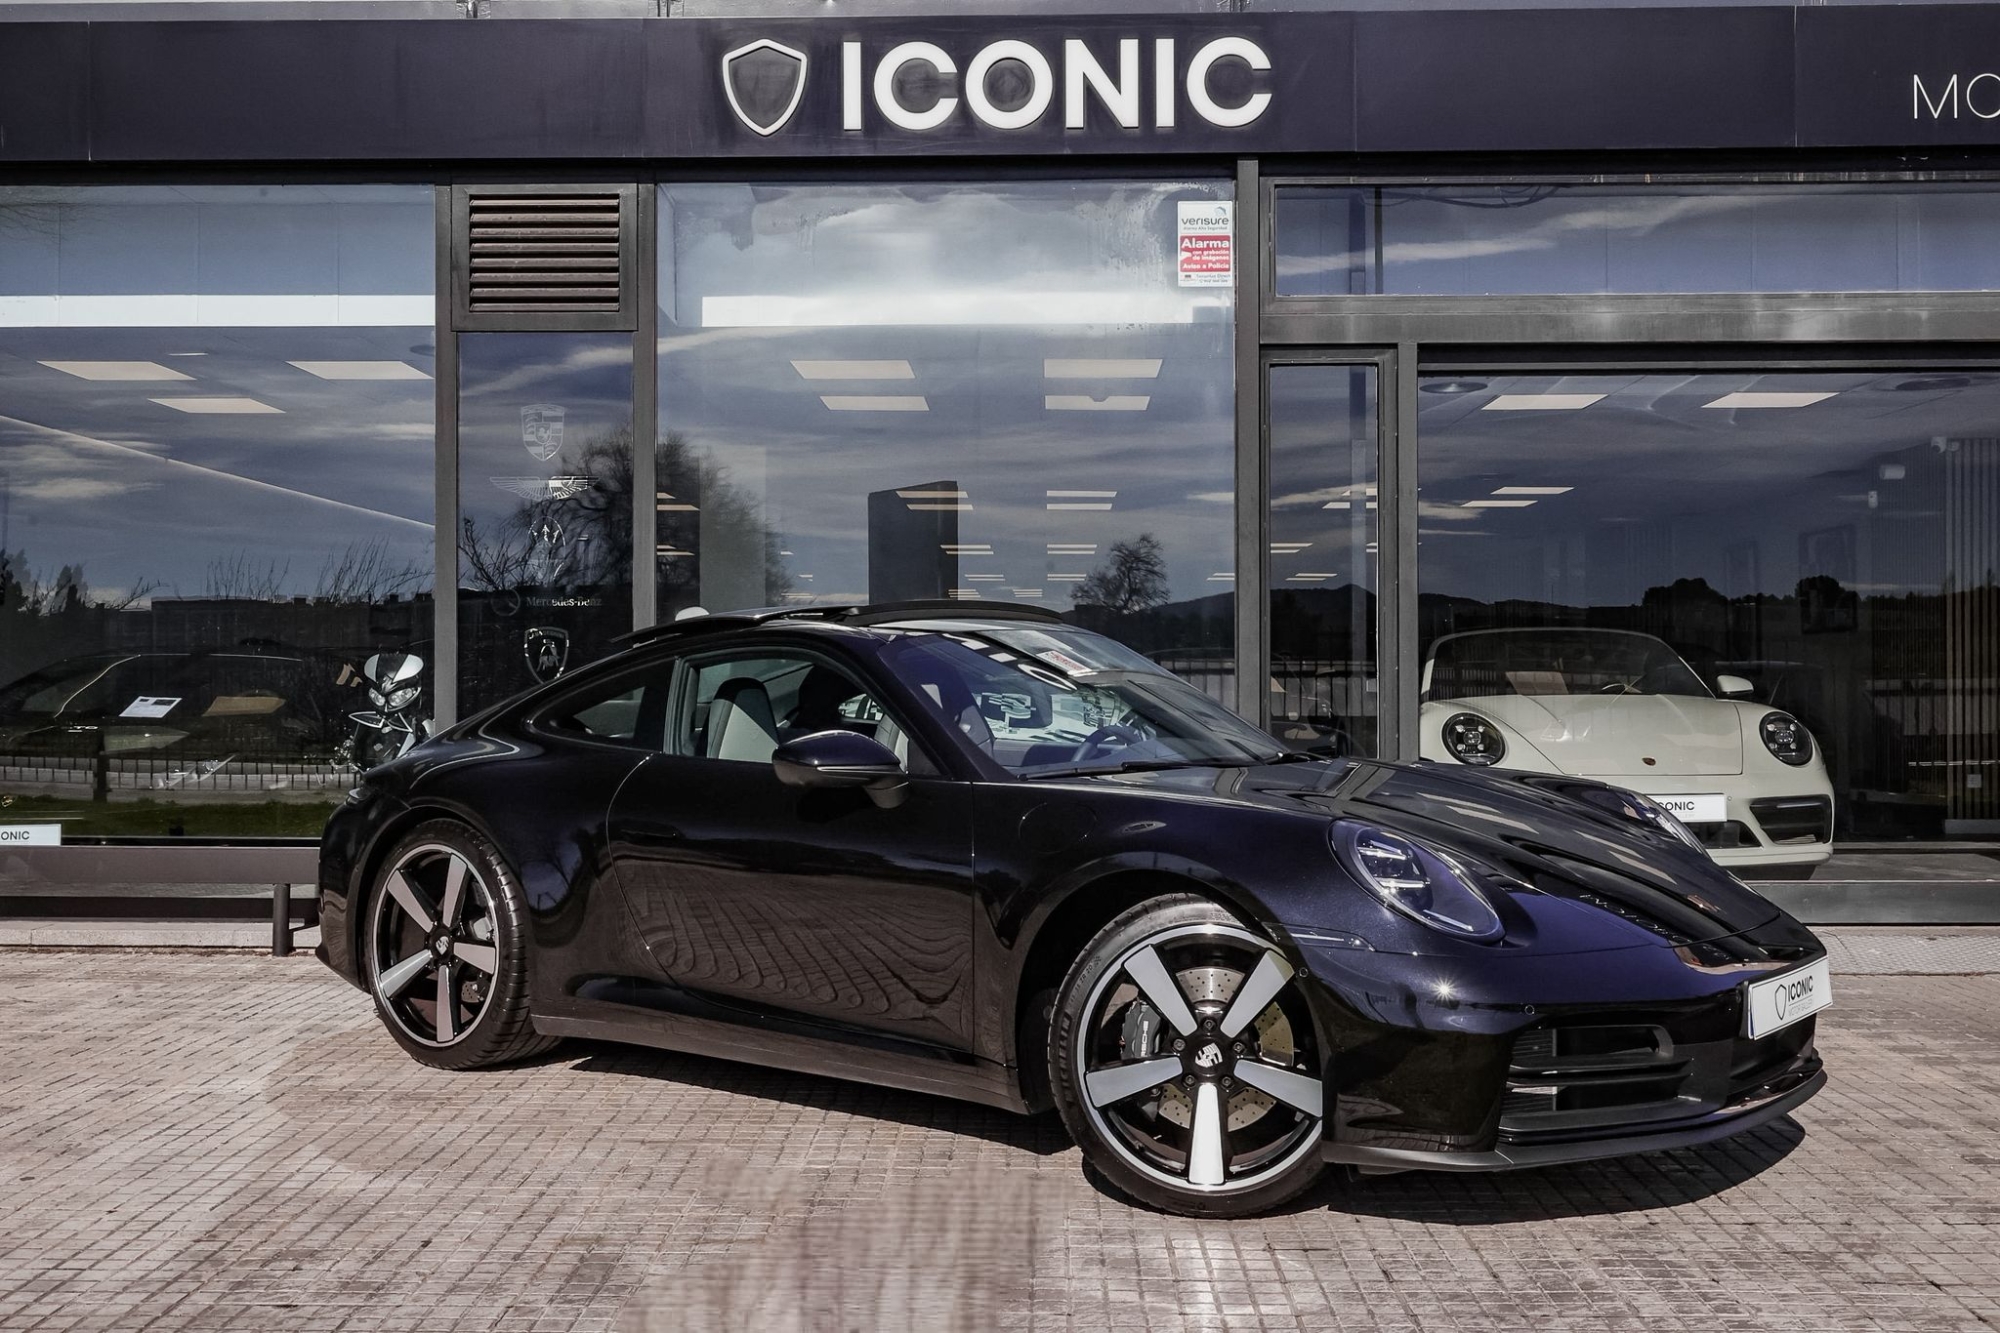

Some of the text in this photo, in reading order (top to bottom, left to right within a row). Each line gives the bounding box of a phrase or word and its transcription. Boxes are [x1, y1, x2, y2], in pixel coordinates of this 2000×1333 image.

[843, 37, 1272, 131] ICONIC
[1913, 73, 2000, 119] MO
[1181, 217, 1229, 225] verisure
[1181, 237, 1229, 248] Alarma
[526, 596, 602, 607] Mercedes-Benz
[0, 830, 30, 841] ONIC
[1788, 975, 1813, 1002] ICONIC
